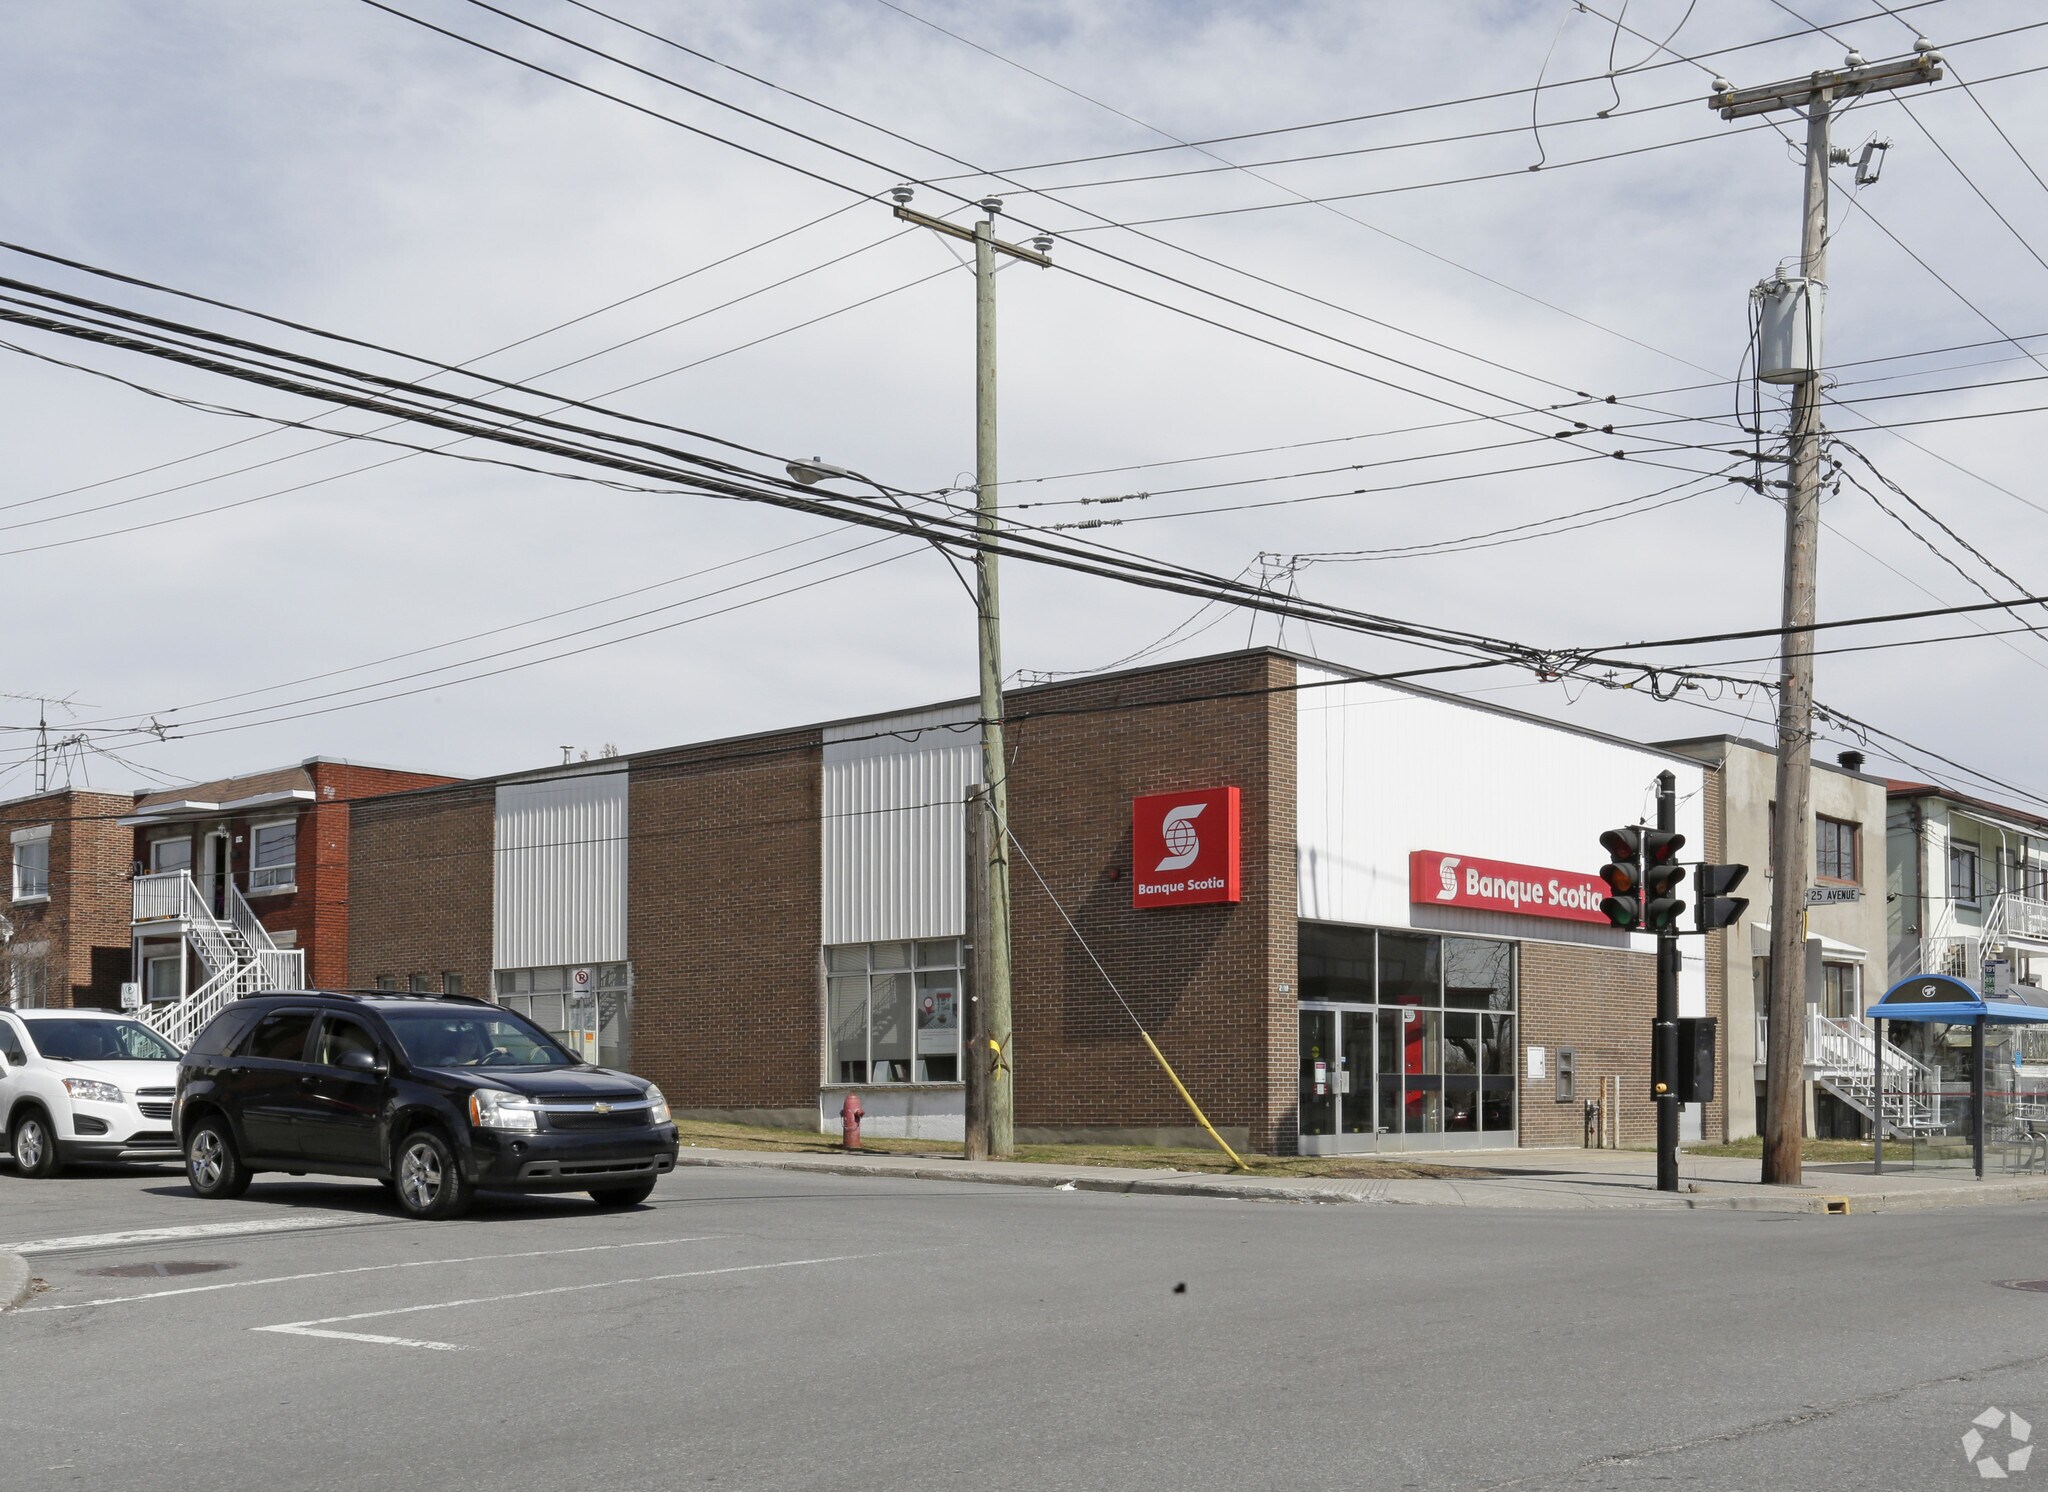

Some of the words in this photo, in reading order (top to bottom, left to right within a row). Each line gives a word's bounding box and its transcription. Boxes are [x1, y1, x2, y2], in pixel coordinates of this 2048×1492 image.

[1138, 882, 1185, 895] Banque
[1187, 876, 1225, 891] Scotia
[1466, 867, 1543, 908] Banque
[1548, 879, 1603, 912] Scotia
[1811, 890, 1823, 901] 25
[1826, 890, 1855, 900] AVENUE
